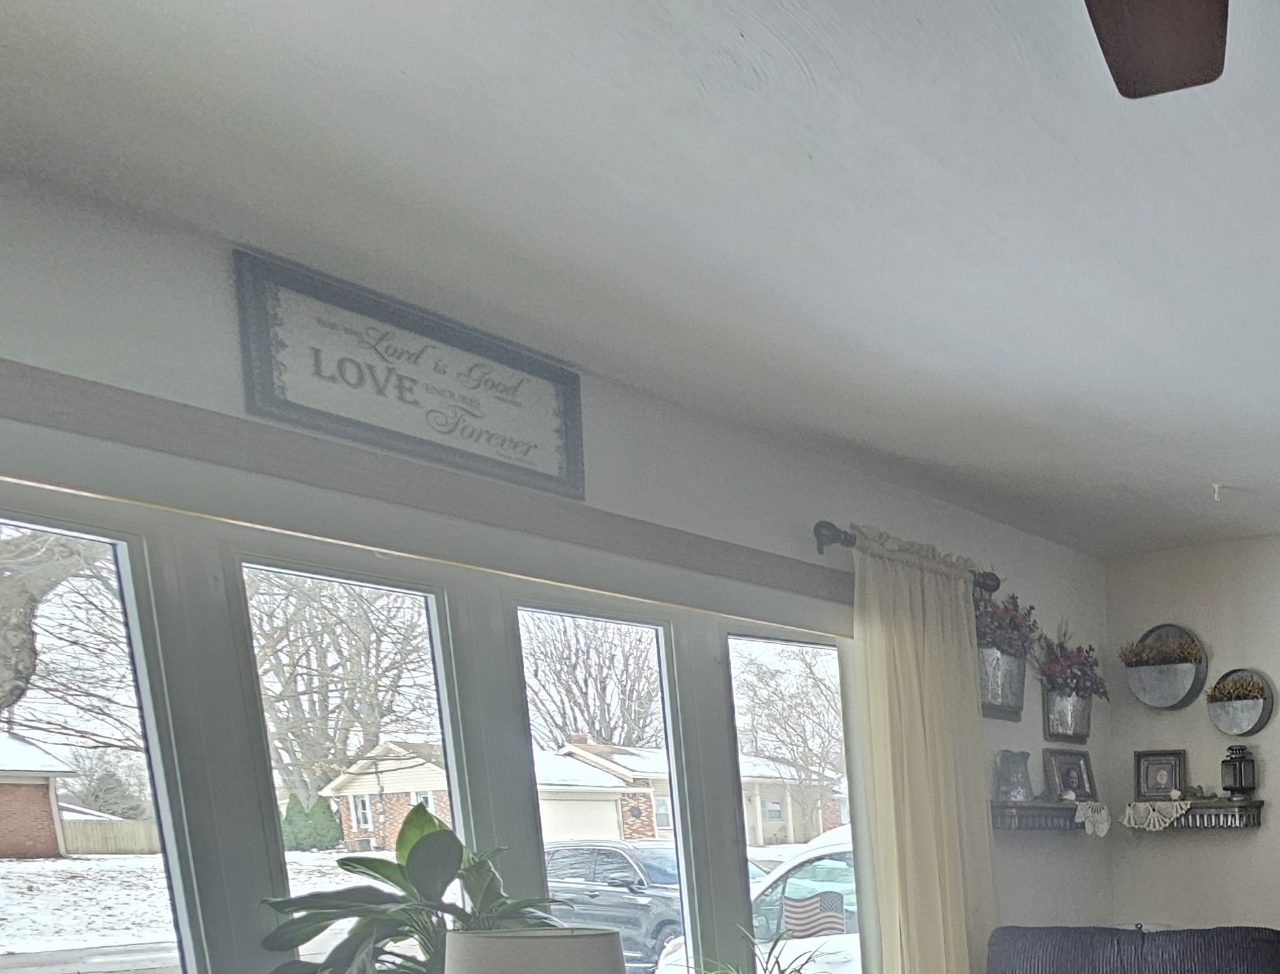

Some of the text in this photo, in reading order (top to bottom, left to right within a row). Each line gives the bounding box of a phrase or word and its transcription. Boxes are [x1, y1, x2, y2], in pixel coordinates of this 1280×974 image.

[310, 346, 422, 410] LOVE
[358, 326, 438, 364] Lord
[433, 358, 447, 375] is
[457, 362, 531, 398] Good
[425, 404, 539, 457] Forever
